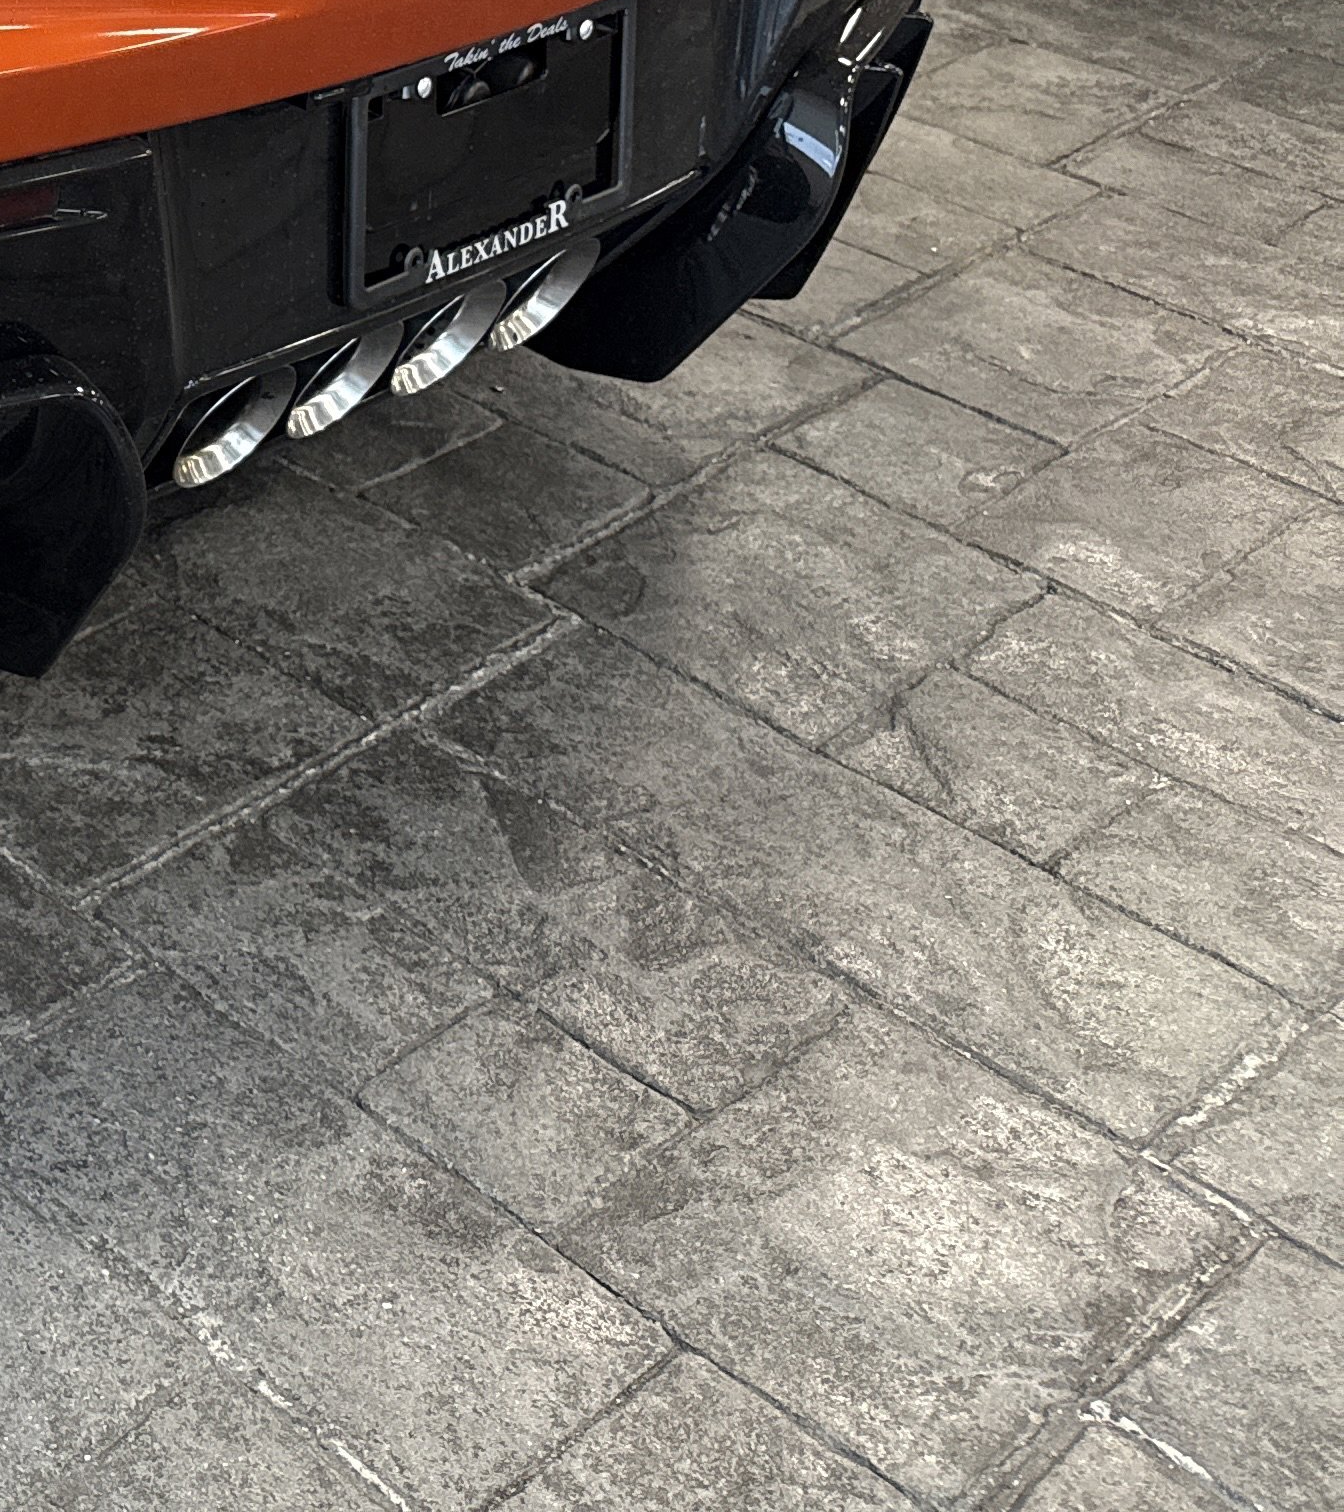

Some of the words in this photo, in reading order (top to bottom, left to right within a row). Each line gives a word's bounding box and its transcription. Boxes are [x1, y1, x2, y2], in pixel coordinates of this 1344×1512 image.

[498, 33, 521, 54] the
[527, 16, 568, 43] Deals
[425, 199, 569, 284] ALEXANDER
